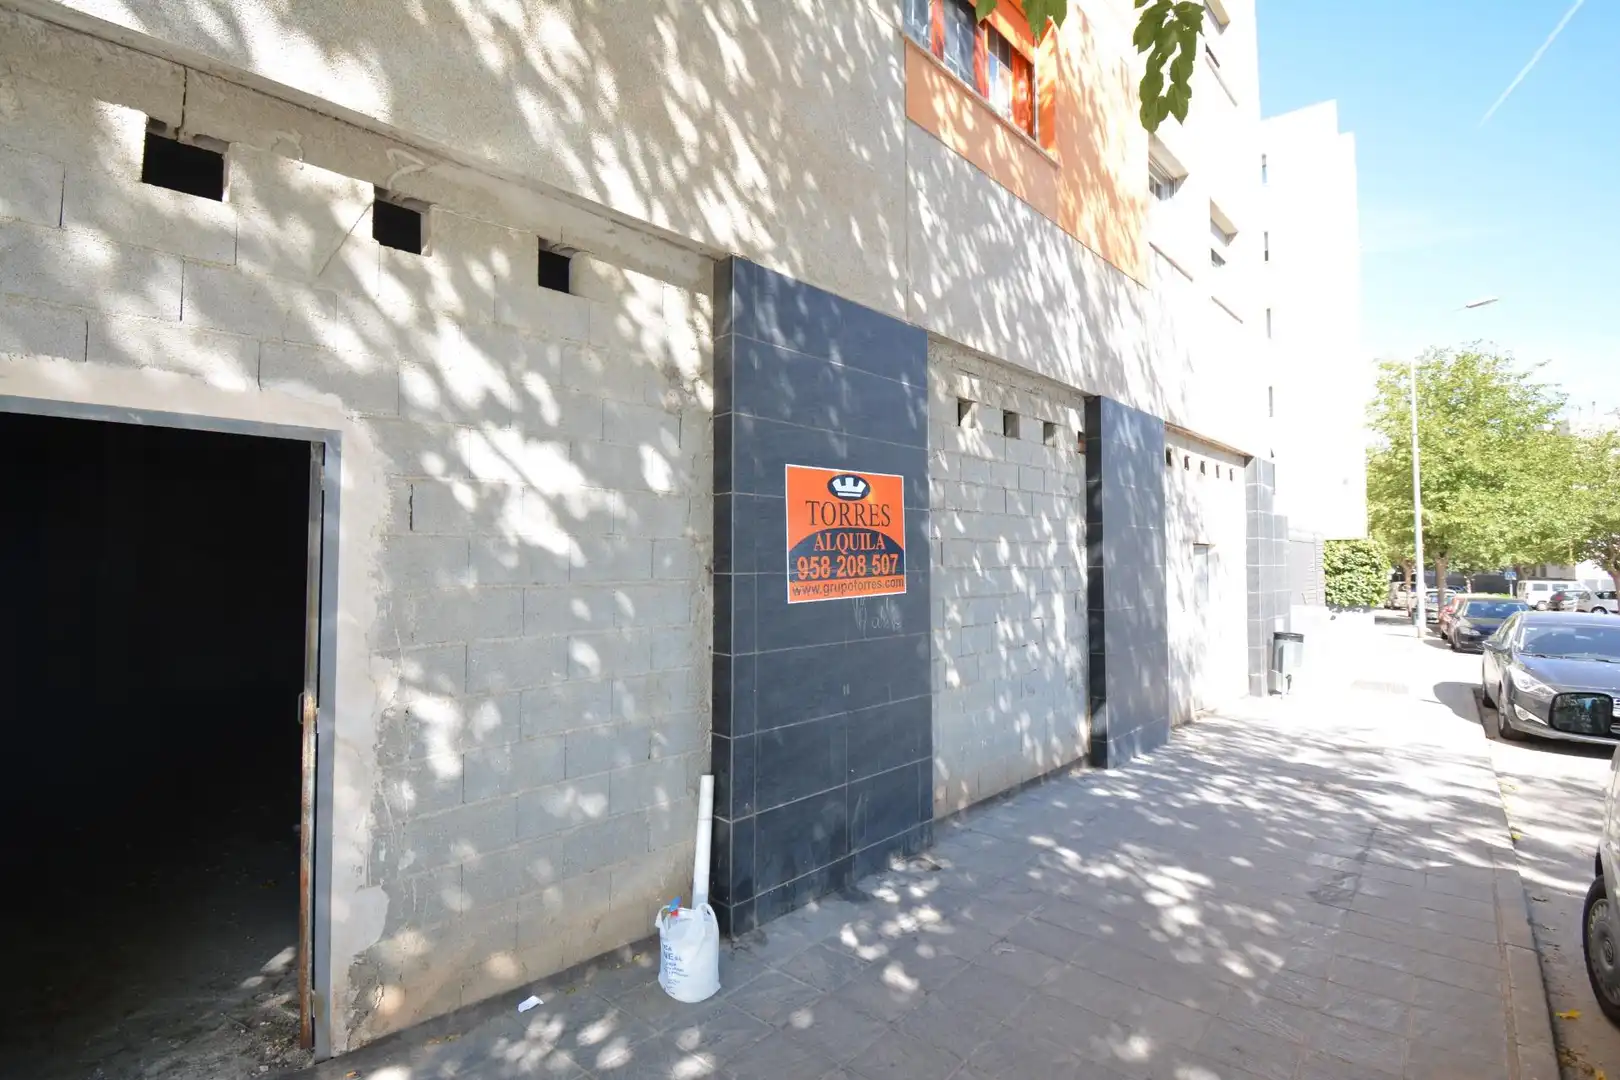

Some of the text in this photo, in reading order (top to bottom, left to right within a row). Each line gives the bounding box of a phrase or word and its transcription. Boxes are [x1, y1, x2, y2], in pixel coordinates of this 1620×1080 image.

[805, 500, 891, 527] TORRES
[813, 532, 886, 554] ALQUILA
[797, 553, 899, 580] 958 208 507
[792, 577, 904, 597] www.grupotorres.com
